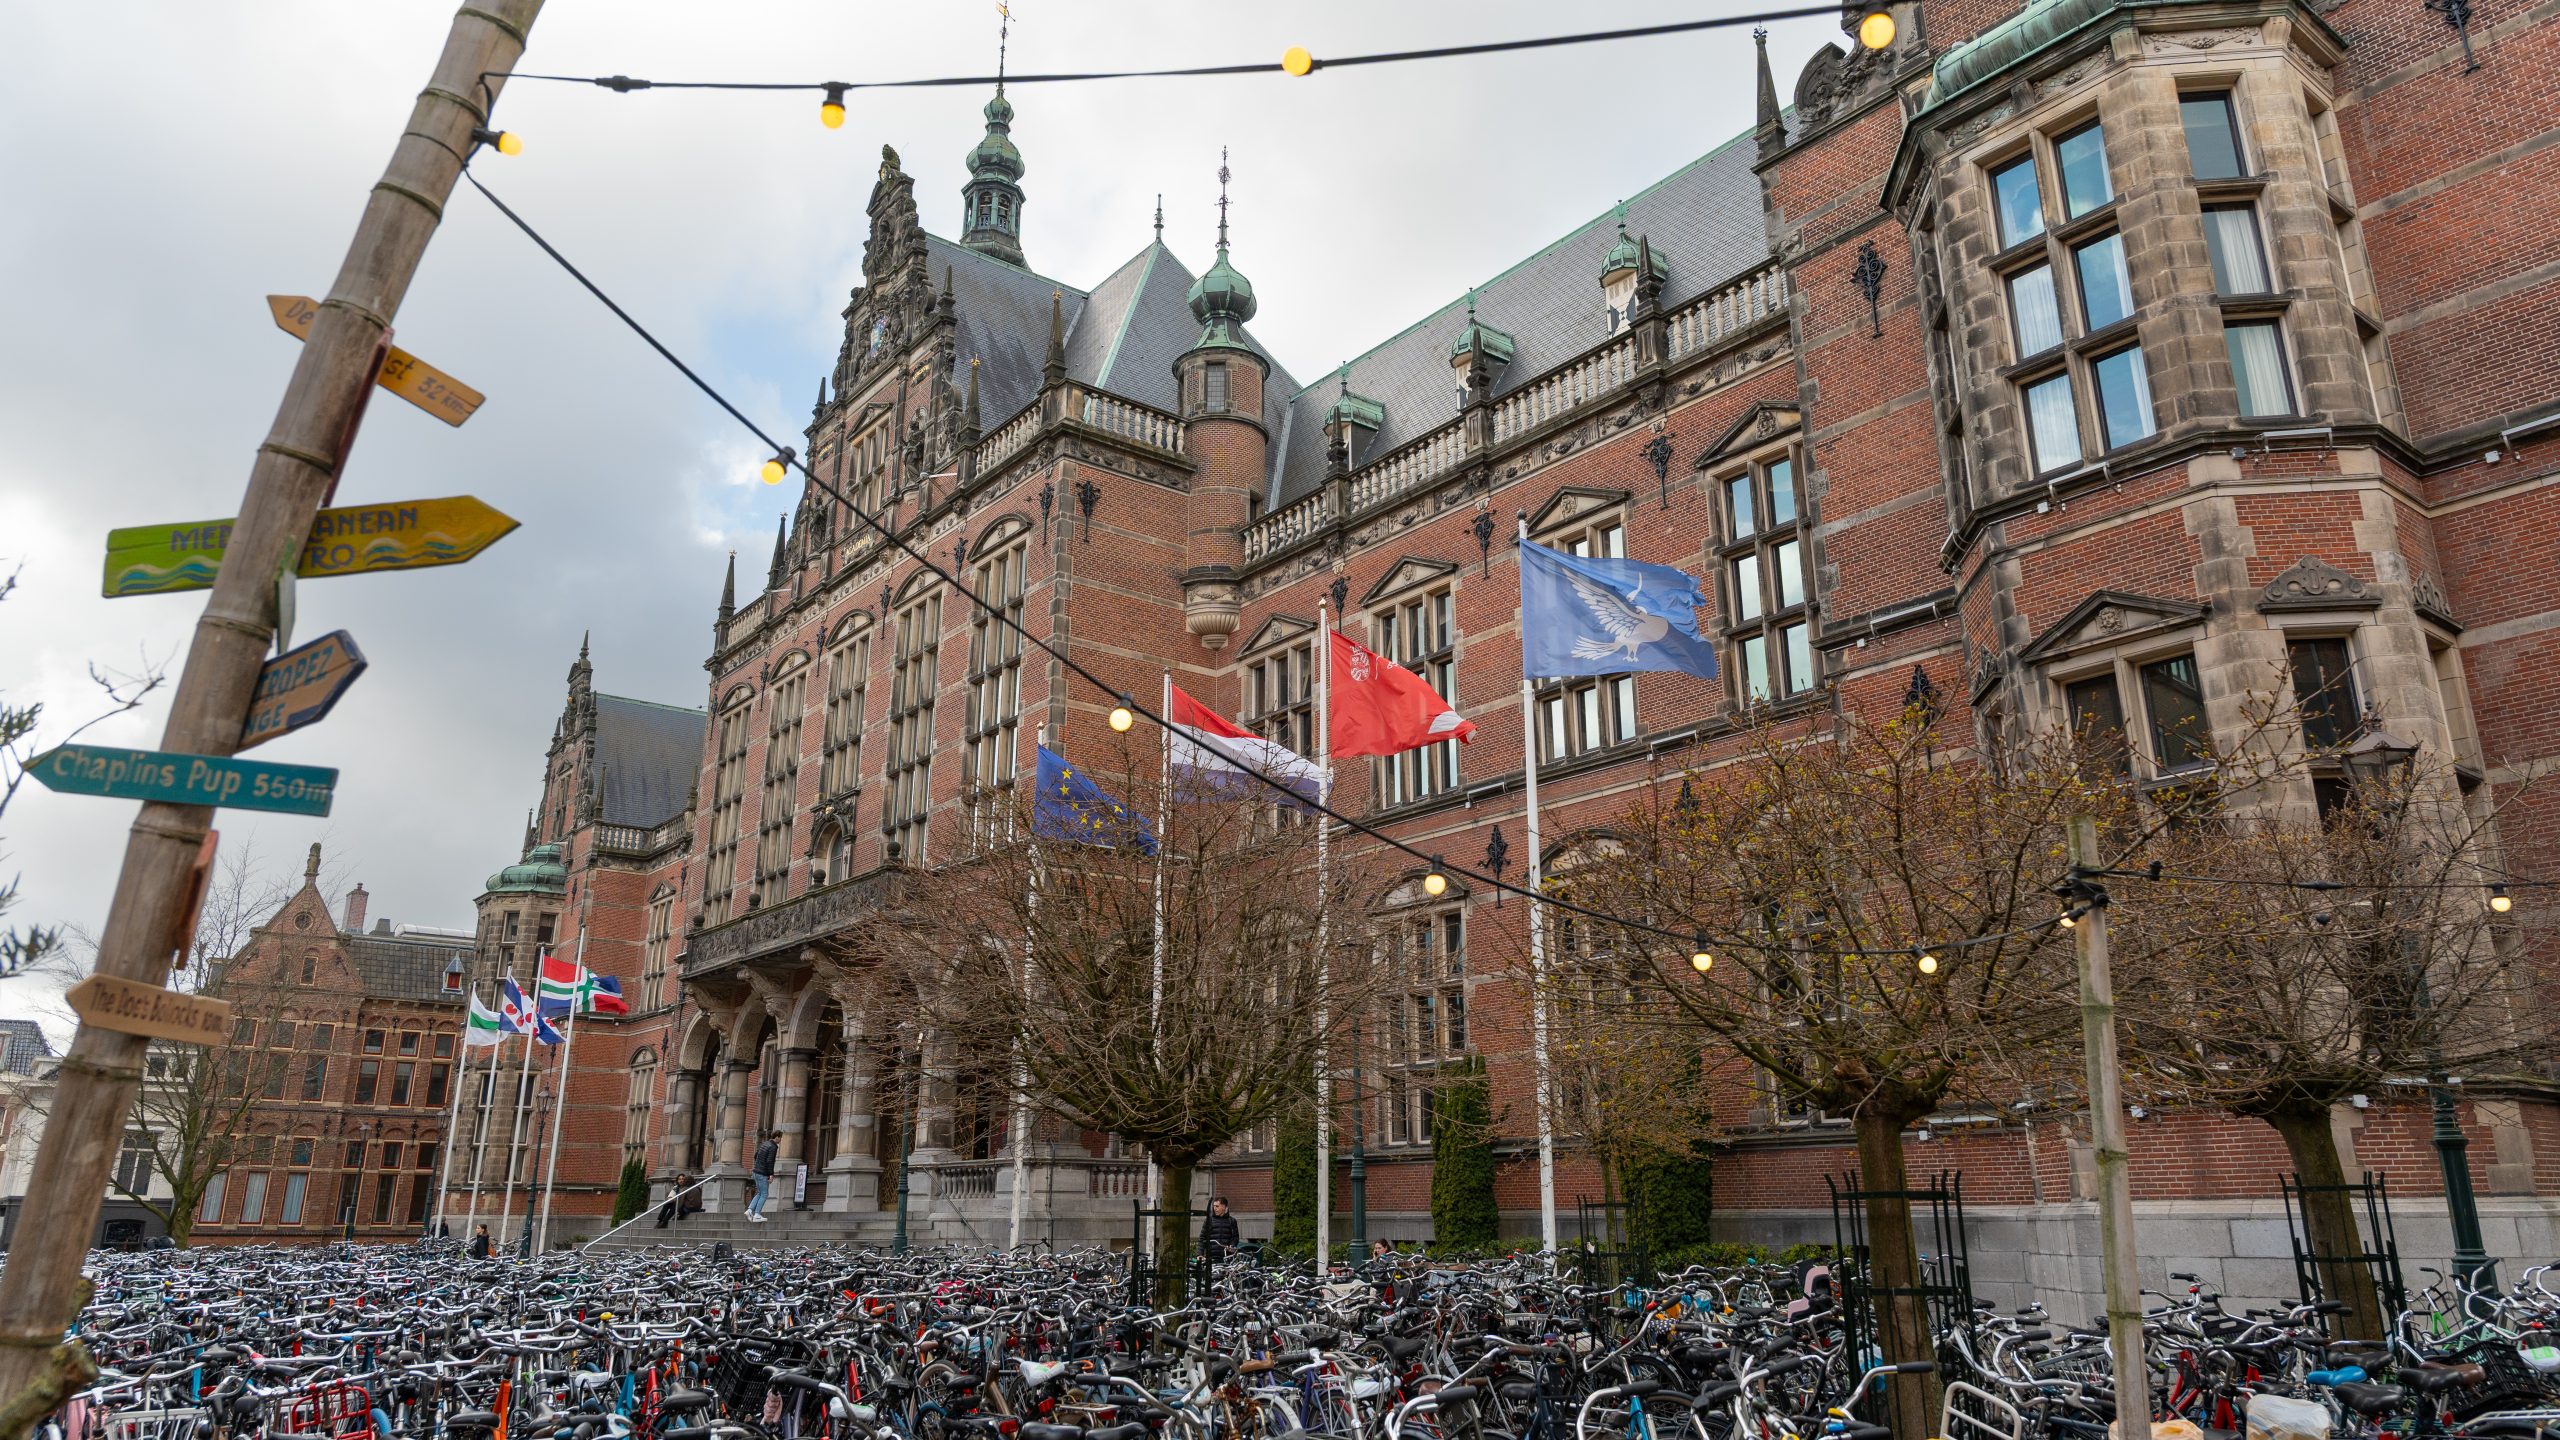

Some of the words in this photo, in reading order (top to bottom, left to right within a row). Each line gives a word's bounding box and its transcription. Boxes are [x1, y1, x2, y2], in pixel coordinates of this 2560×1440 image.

[384, 355, 416, 381] st
[417, 375, 446, 400] 32
[53, 749, 176, 791] Chaplins
[187, 760, 241, 801] Pup
[90, 982, 115, 1013] The
